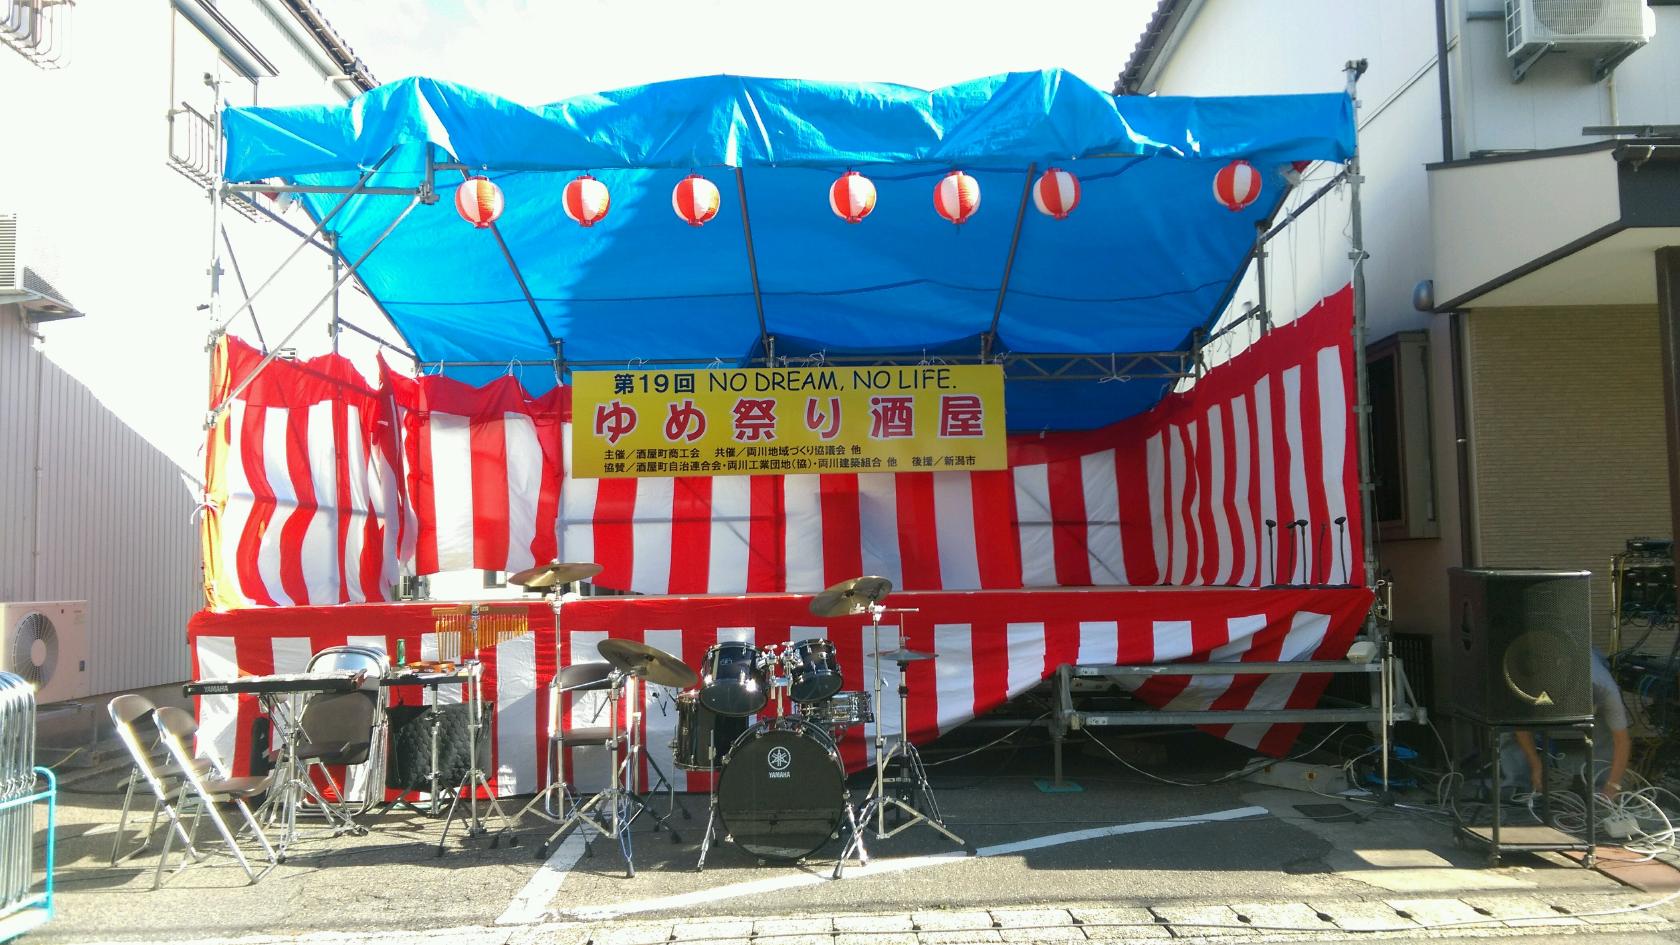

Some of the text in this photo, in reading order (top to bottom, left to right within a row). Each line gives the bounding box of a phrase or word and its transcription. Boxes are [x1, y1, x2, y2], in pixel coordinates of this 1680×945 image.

[614, 368, 957, 395] 第19回 NO DREAM, NO LIFE.
[595, 395, 984, 444] ゆめ祭り酒屋
[604, 444, 862, 460] 主催／酒屋町商工会 共催／両川地域づくり協議会 他
[887, 456, 898, 468] 他
[912, 455, 976, 467] 後援／新潟市
